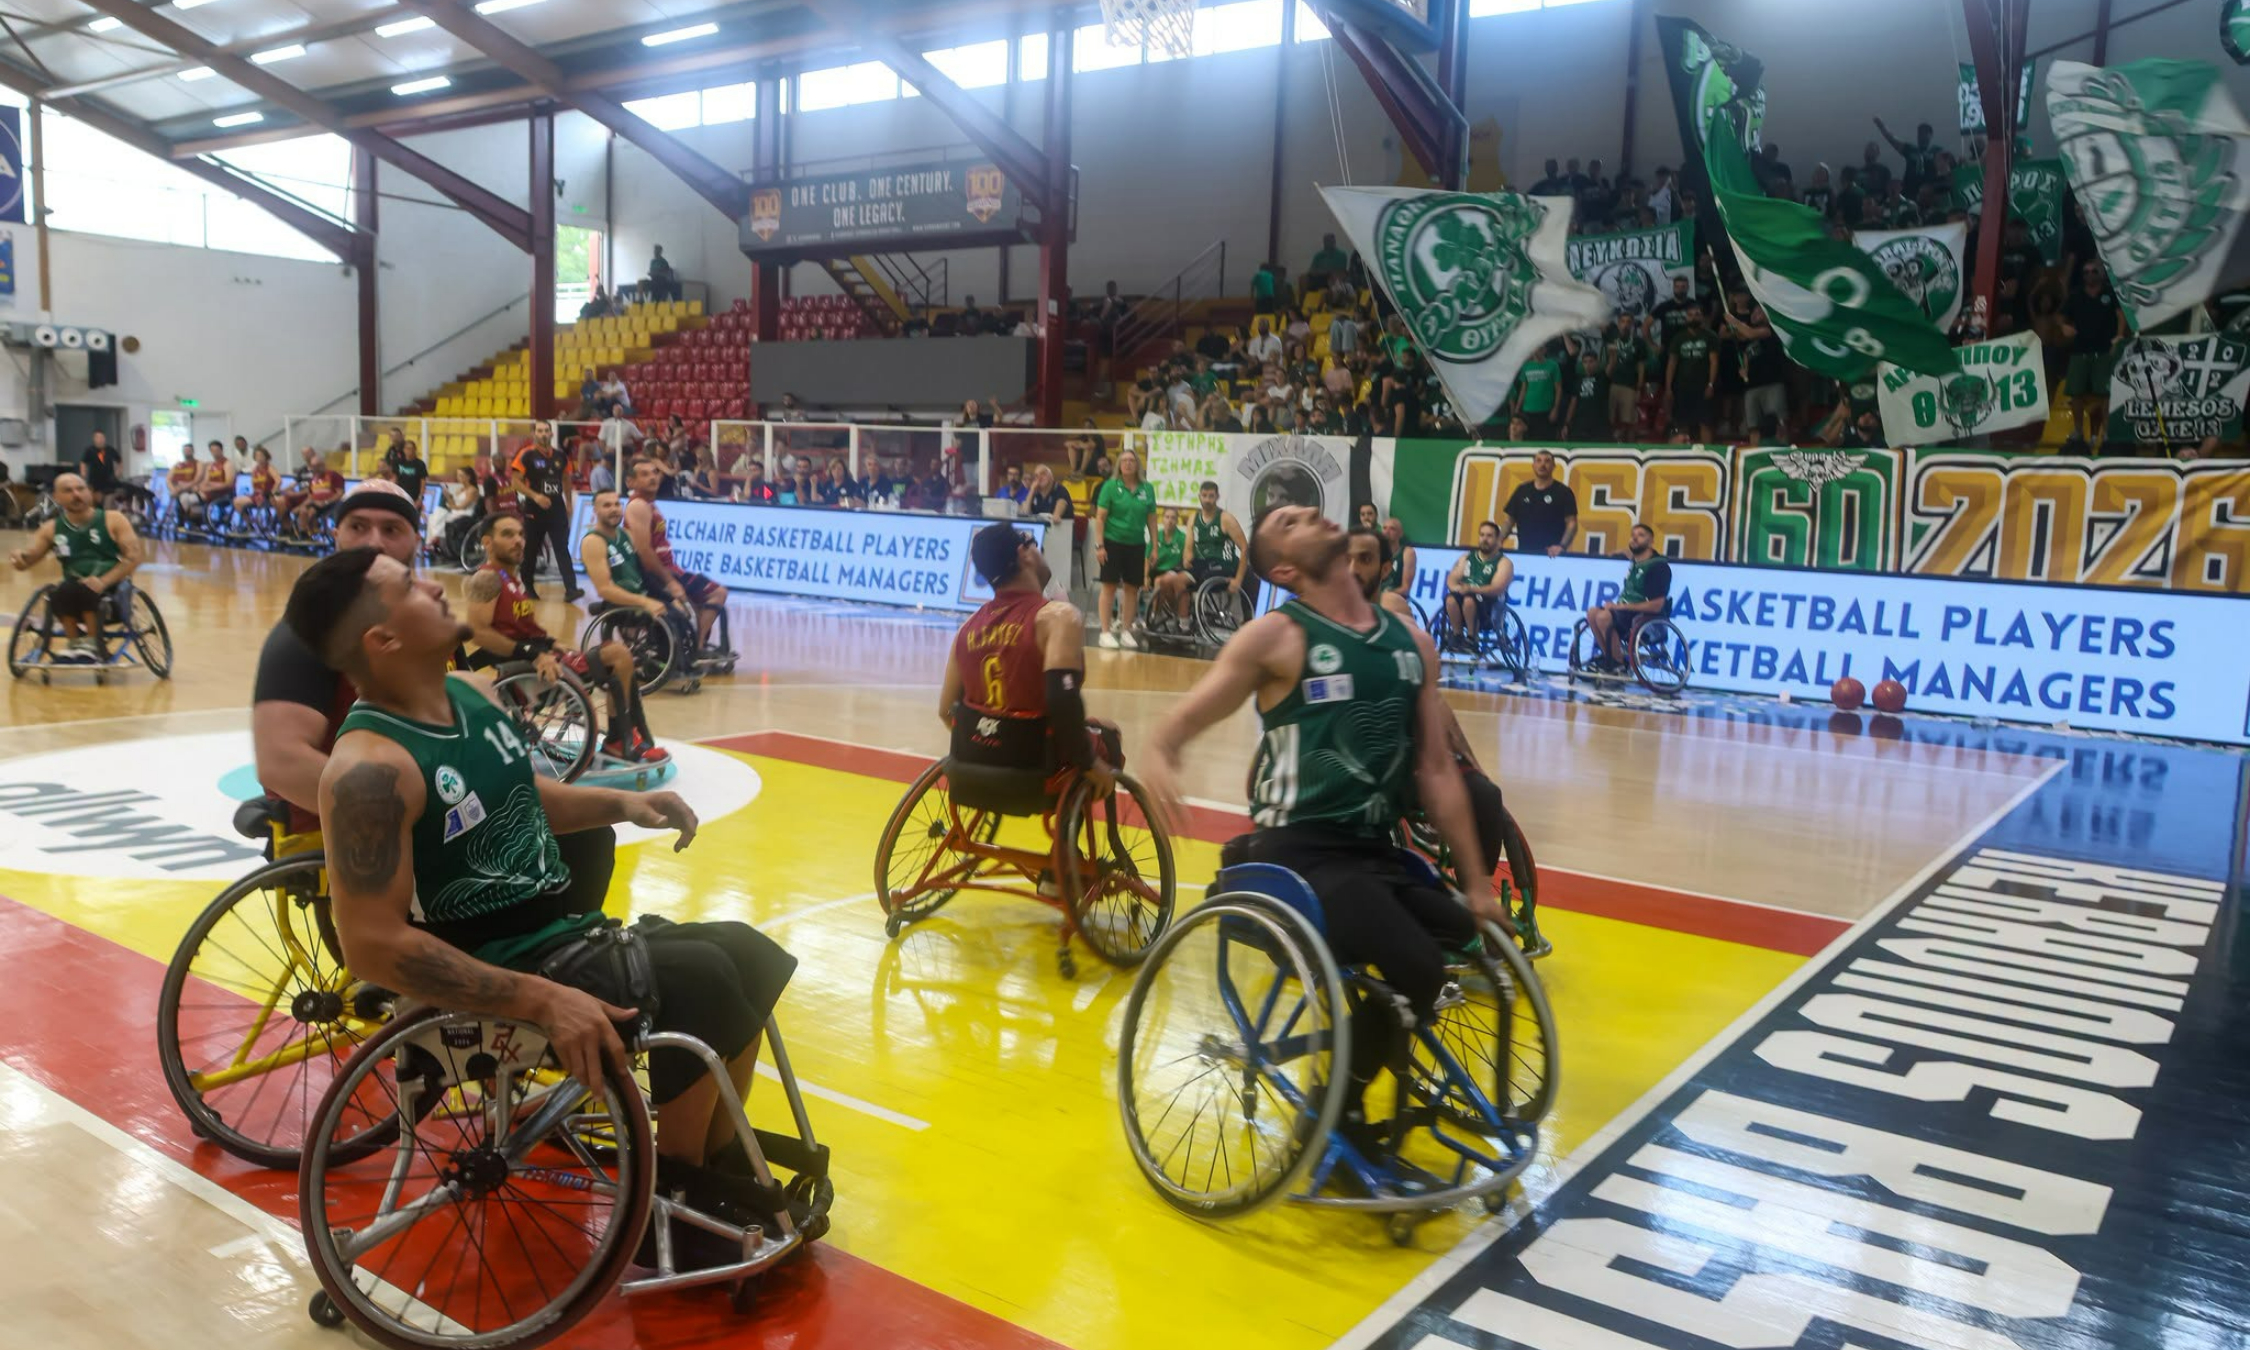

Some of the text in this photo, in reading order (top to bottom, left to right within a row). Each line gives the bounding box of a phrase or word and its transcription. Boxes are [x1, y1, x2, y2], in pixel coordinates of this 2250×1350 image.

[753, 194, 780, 215] 100
[791, 185, 816, 208] ONE
[868, 176, 893, 200] ONE
[896, 169, 954, 197] CENTURY.
[967, 170, 1000, 196] 100
[833, 201, 906, 229] ONE LEGACY.
[1996, 369, 2038, 413] 13
[544, 481, 560, 495] bx
[1459, 451, 1725, 562] 166
[666, 518, 950, 562] ELCHAIR BASKETBALL PLAYERS
[1744, 466, 1888, 572] 60
[674, 549, 949, 595] TURE BASKETBALL MANAGERS
[1671, 585, 1920, 639] ASKETBALL
[1941, 606, 2176, 661] PLAYERS
[985, 655, 1004, 710] 6
[1674, 637, 2177, 721] KETBALL MANAGERS
[483, 720, 526, 766] 14
